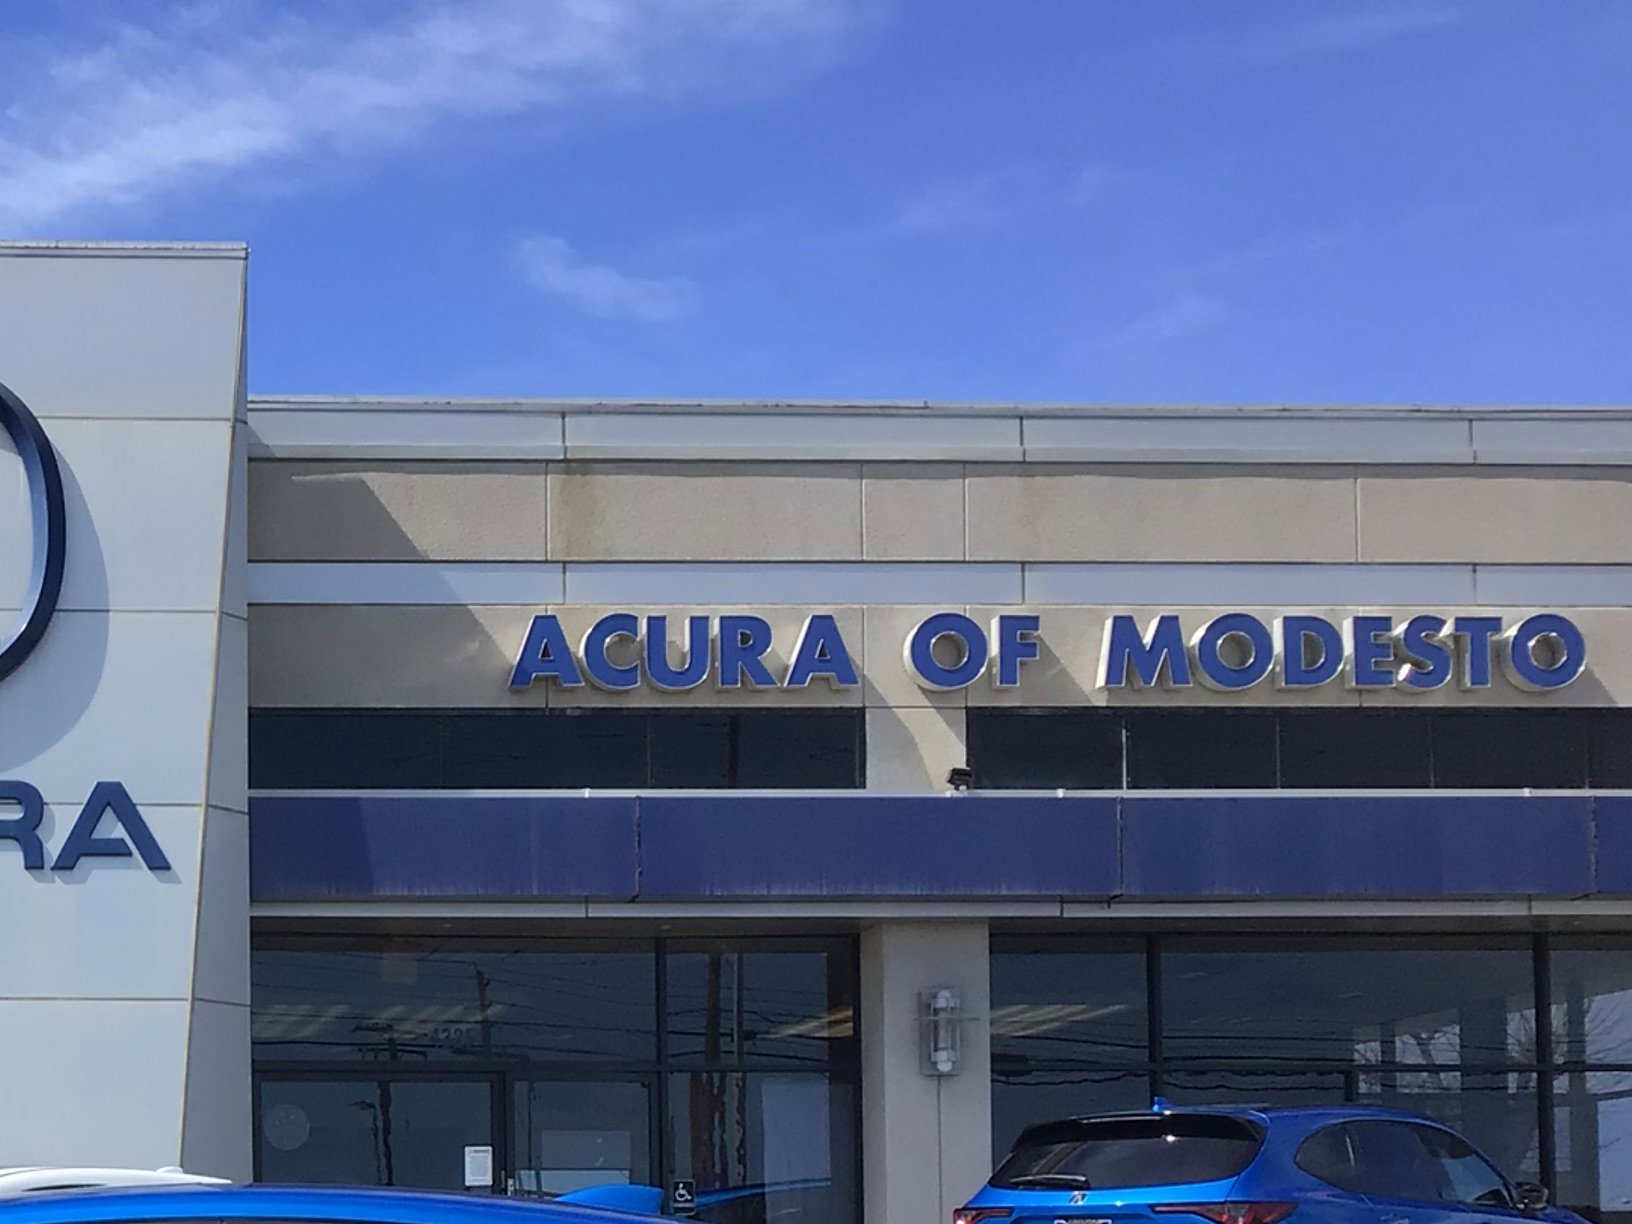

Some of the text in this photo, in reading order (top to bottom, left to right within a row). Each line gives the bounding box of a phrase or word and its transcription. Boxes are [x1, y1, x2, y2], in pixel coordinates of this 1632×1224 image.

[509, 612, 1586, 691] ACURA OF MODESTO
